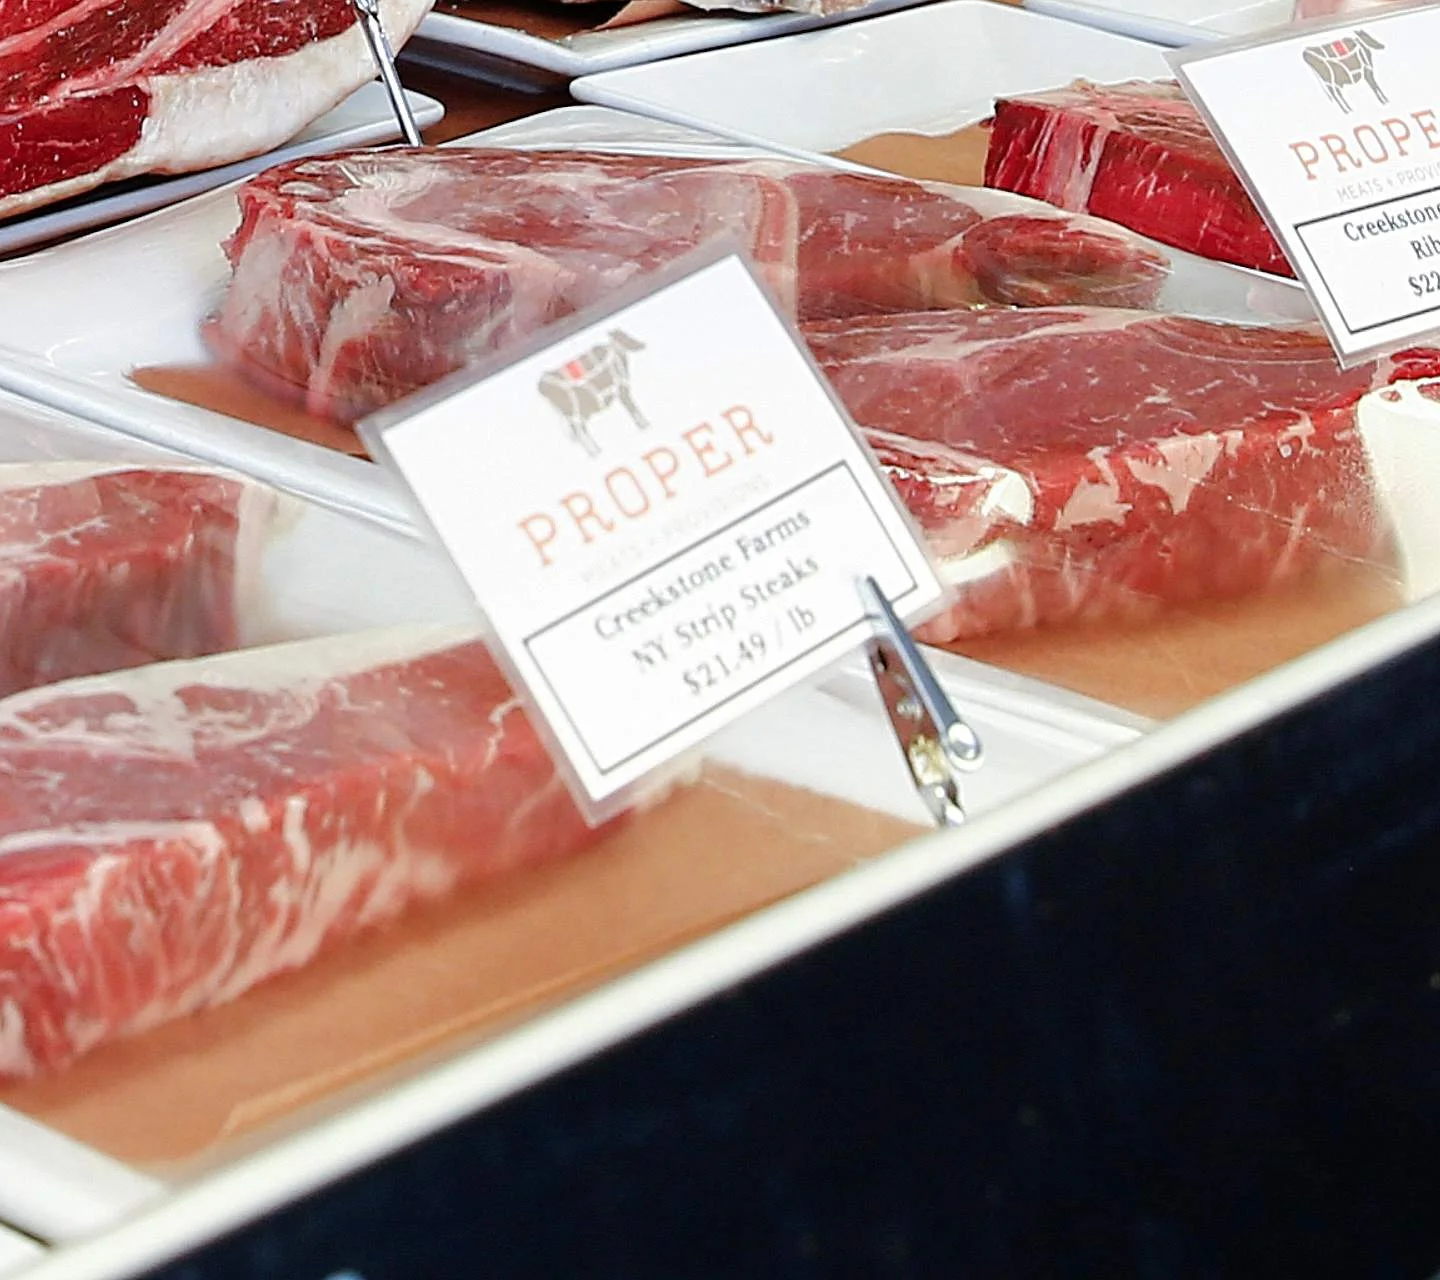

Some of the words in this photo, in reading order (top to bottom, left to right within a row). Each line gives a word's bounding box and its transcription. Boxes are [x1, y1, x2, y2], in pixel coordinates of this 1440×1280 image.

[1335, 177, 1385, 205] MEATS
[516, 403, 776, 568] PROPER
[593, 541, 737, 642] Creekstone
[736, 508, 811, 563] Farms
[630, 634, 672, 675] NY
[674, 598, 741, 652] Strip
[739, 553, 821, 610] Steaks
[681, 630, 768, 698] $21.49
[788, 603, 817, 633] lb
